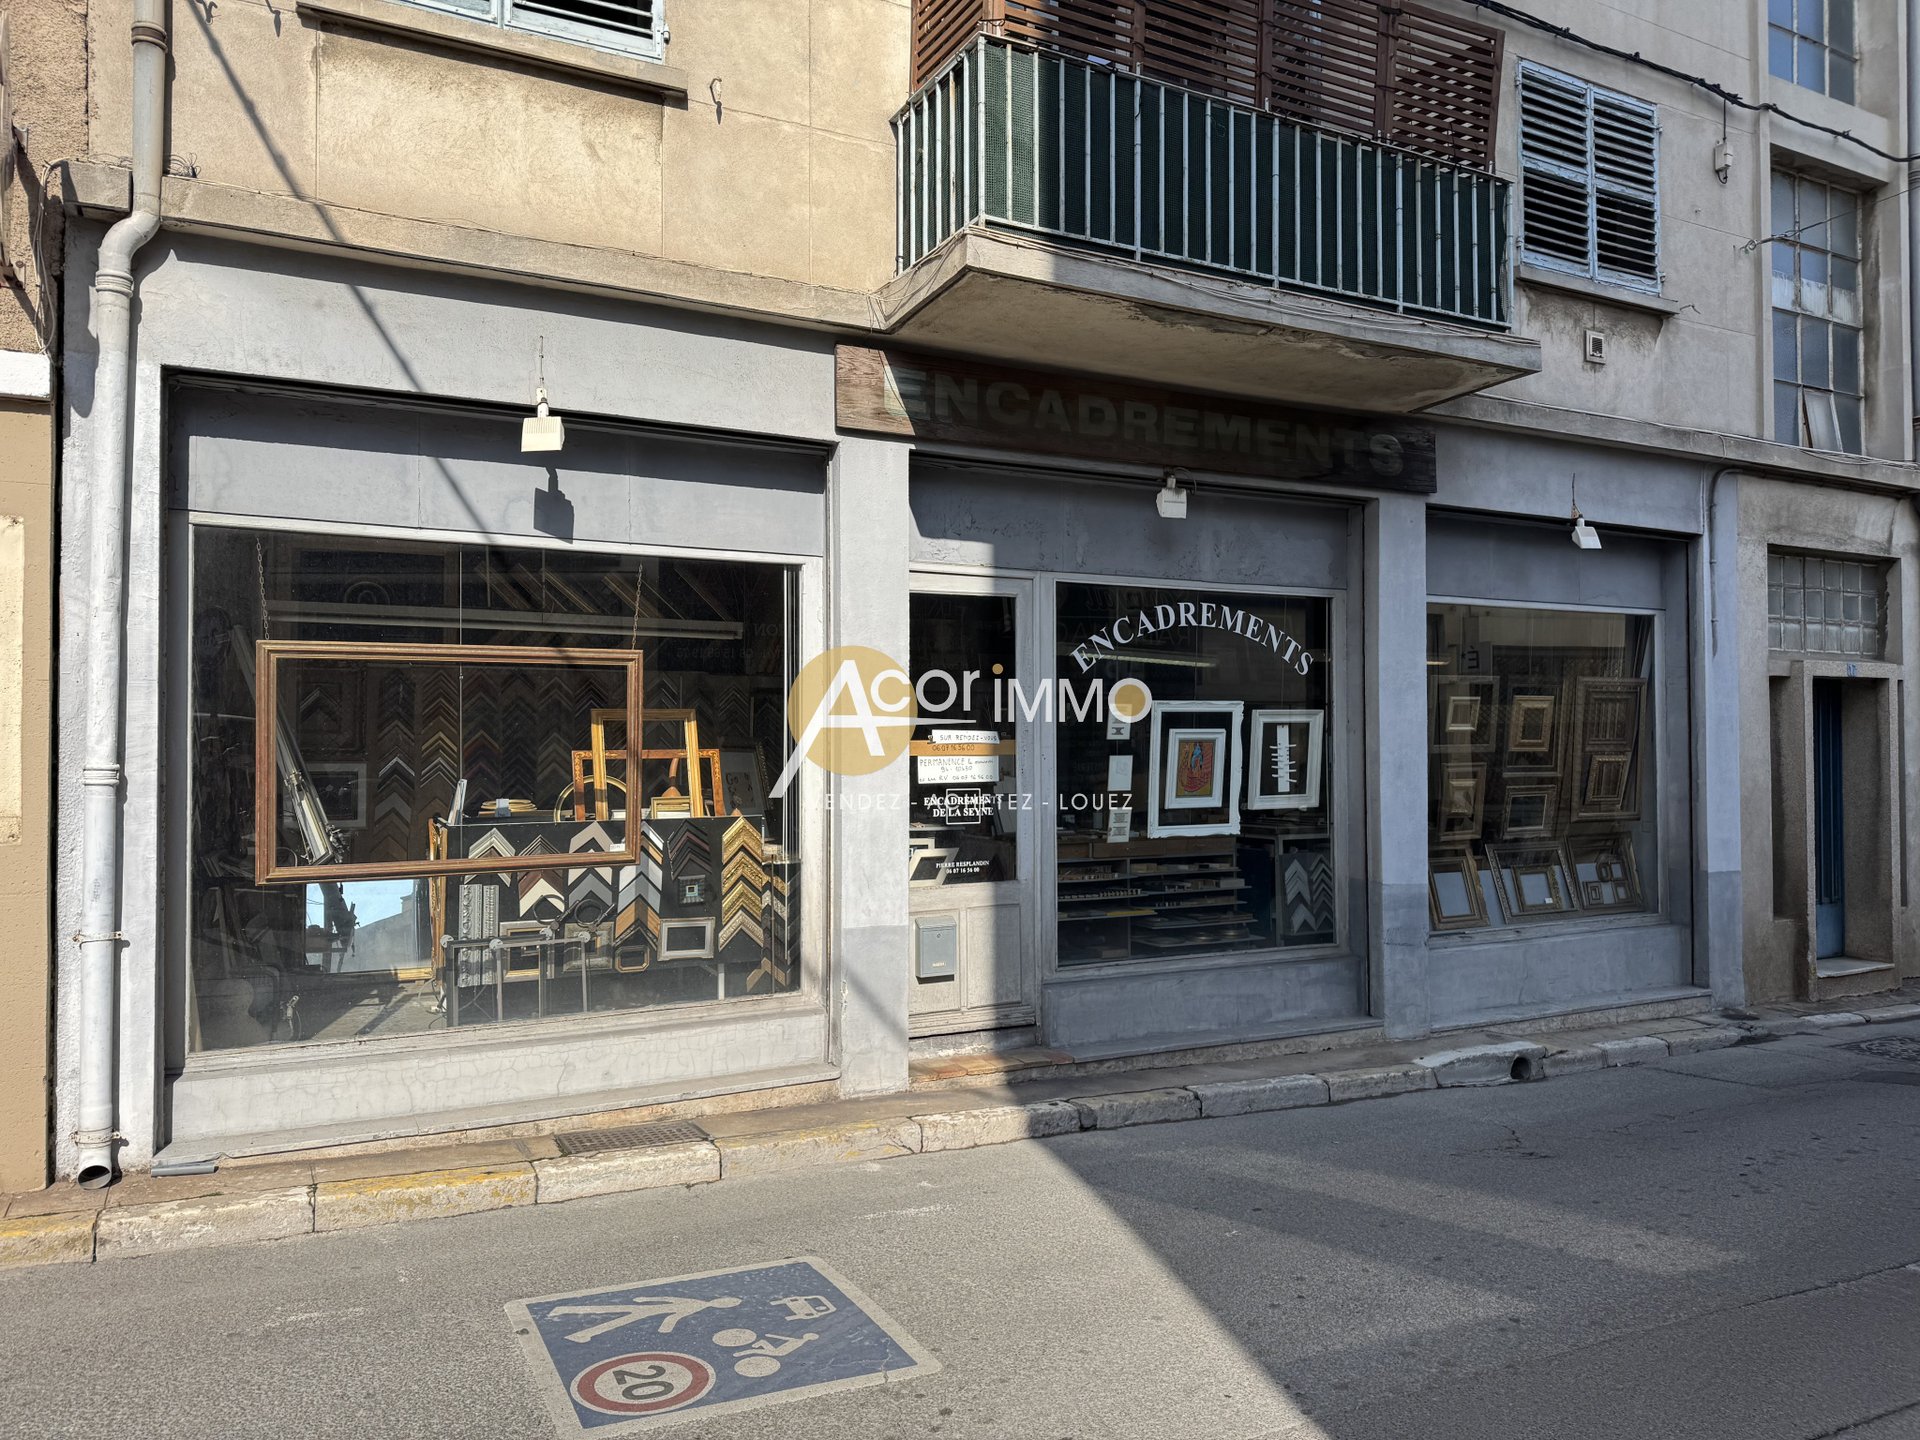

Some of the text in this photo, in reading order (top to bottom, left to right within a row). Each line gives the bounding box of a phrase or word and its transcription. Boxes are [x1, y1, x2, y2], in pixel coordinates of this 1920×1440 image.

[884, 367, 1405, 477] ENCADREMENTS
[1070, 602, 1314, 676] ENCADREMENTS
[924, 795, 1002, 806] ENCADREMENTS
[933, 807, 994, 817] DE LA SEYNE
[612, 1365, 674, 1400] 20
